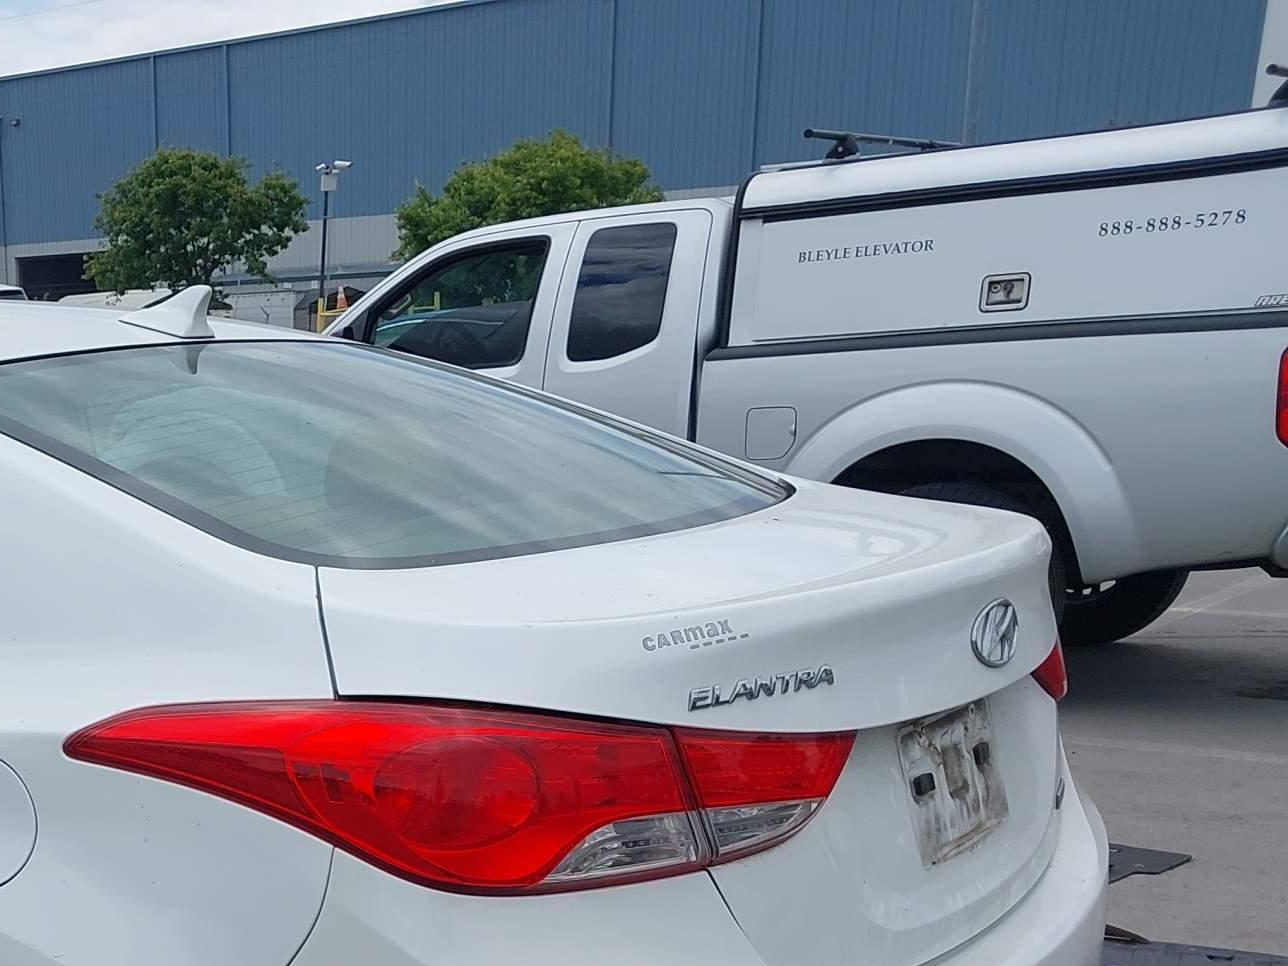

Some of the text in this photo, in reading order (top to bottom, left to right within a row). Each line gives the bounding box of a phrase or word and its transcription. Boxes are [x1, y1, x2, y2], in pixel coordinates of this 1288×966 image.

[1098, 209, 1246, 237] 888-888-5278
[798, 239, 935, 264] BLEYLE ELEVATOR
[688, 664, 836, 712] ELANTRA
